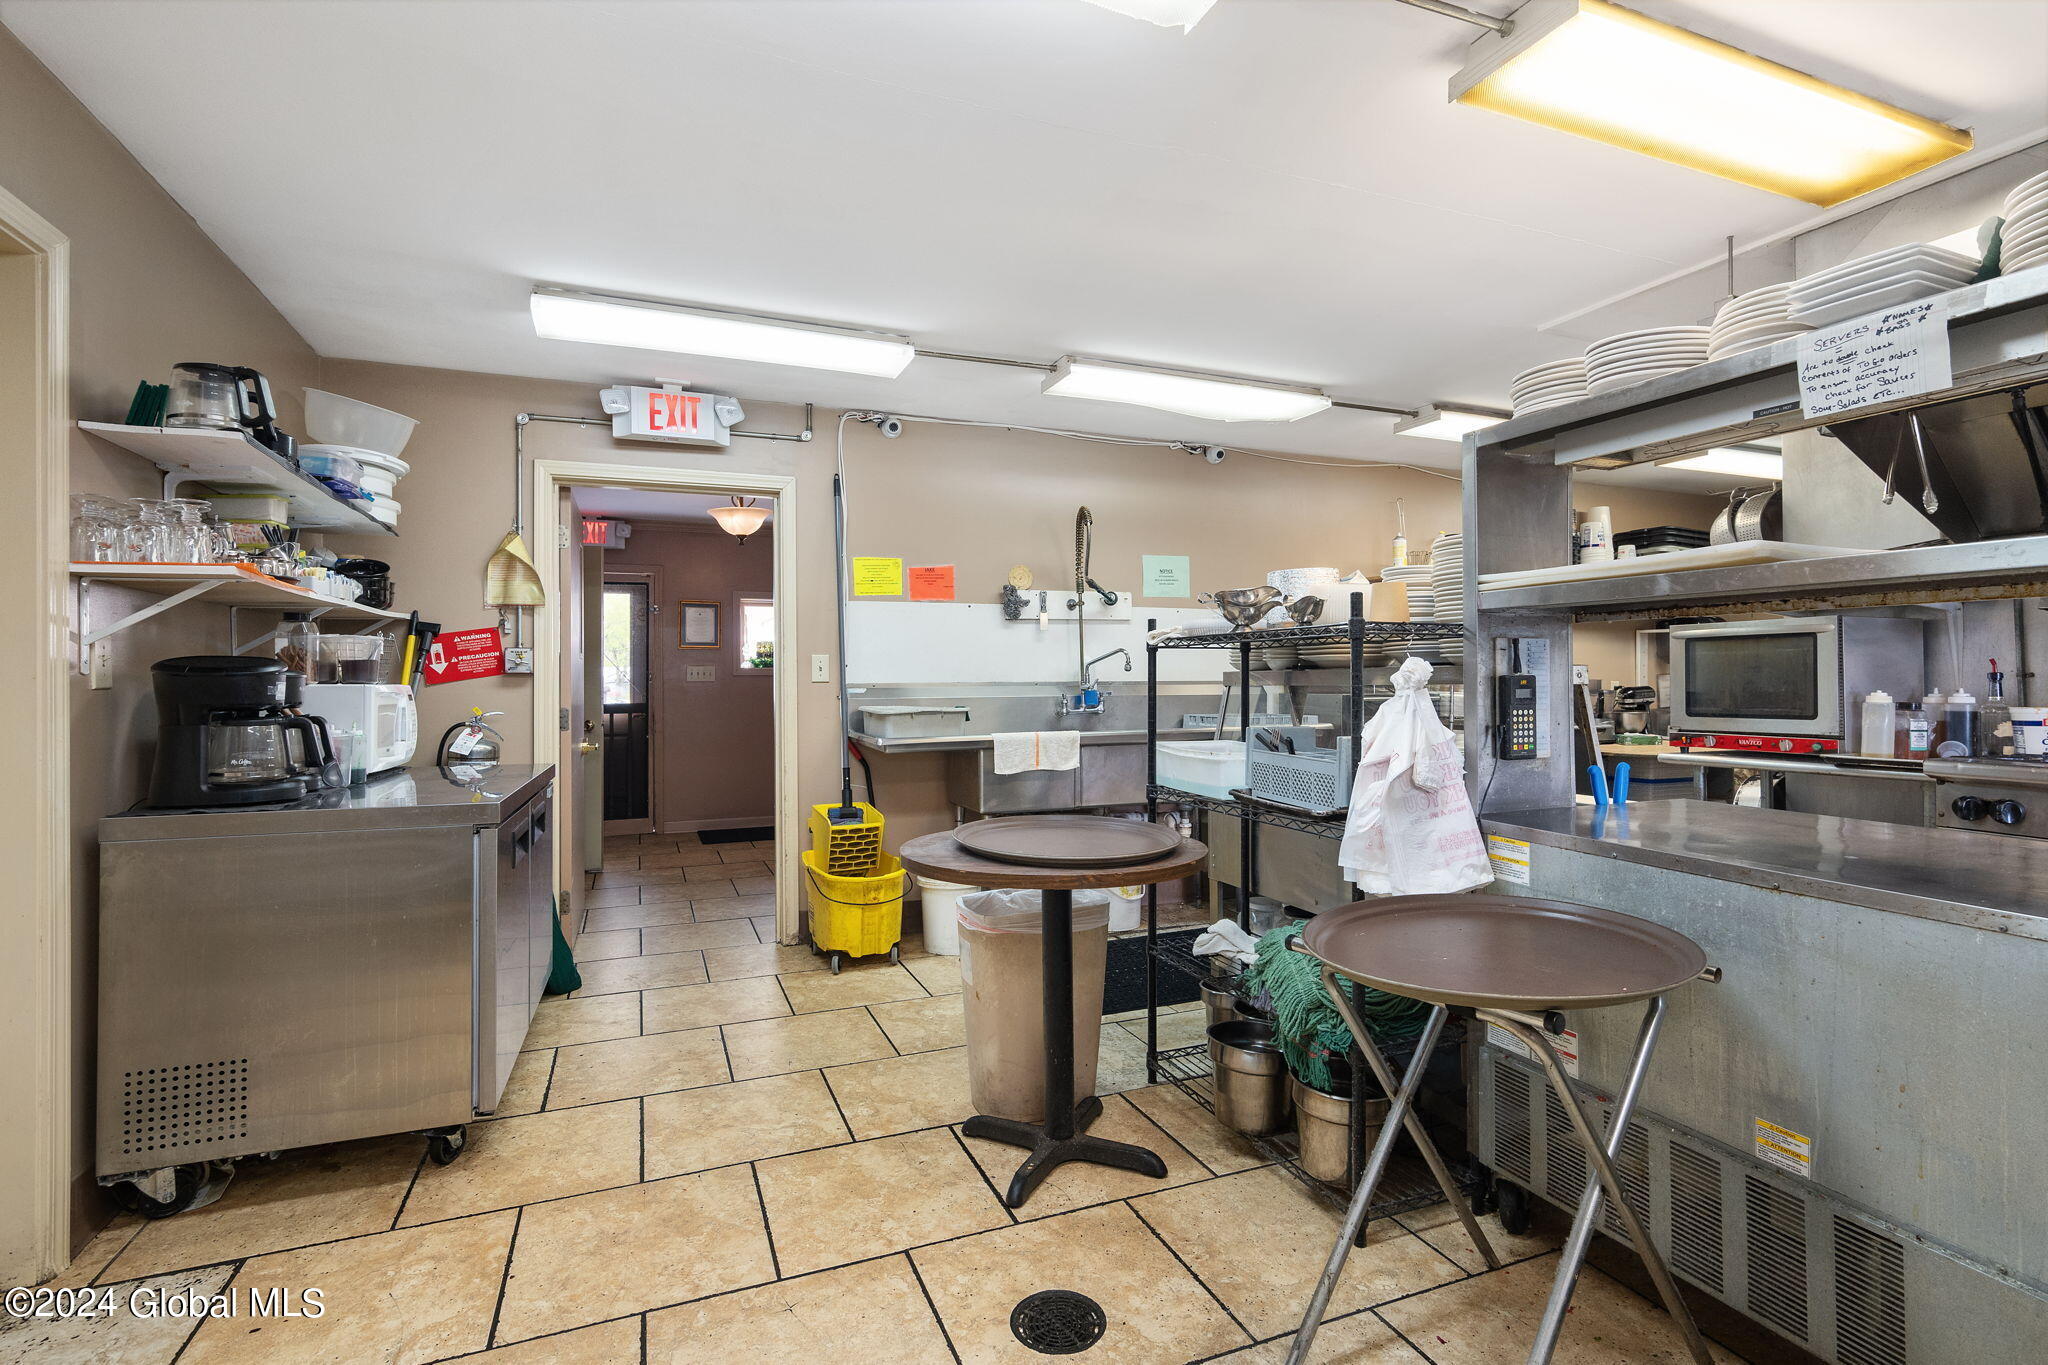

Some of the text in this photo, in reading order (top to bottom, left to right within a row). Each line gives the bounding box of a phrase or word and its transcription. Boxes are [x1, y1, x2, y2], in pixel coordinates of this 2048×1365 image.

[1892, 305, 1924, 320] NAMES
[1813, 325, 1870, 351] SERVERS
[1802, 363, 1819, 374] Are
[1842, 366, 1851, 374] of
[1888, 348, 1918, 361] orders
[1821, 379, 1849, 390] ensure
[1854, 366, 1900, 382] accuracy
[1855, 382, 1872, 392] for
[648, 392, 702, 433] EXIT
[1760, 407, 1780, 416] CAUTION
[582, 521, 608, 544] XIT
[460, 632, 492, 641] WARNING
[458, 651, 500, 661] PRECAUCION
[1775, 1127, 1796, 1139] Caution
[1770, 1142, 1802, 1159] ATTENTION
